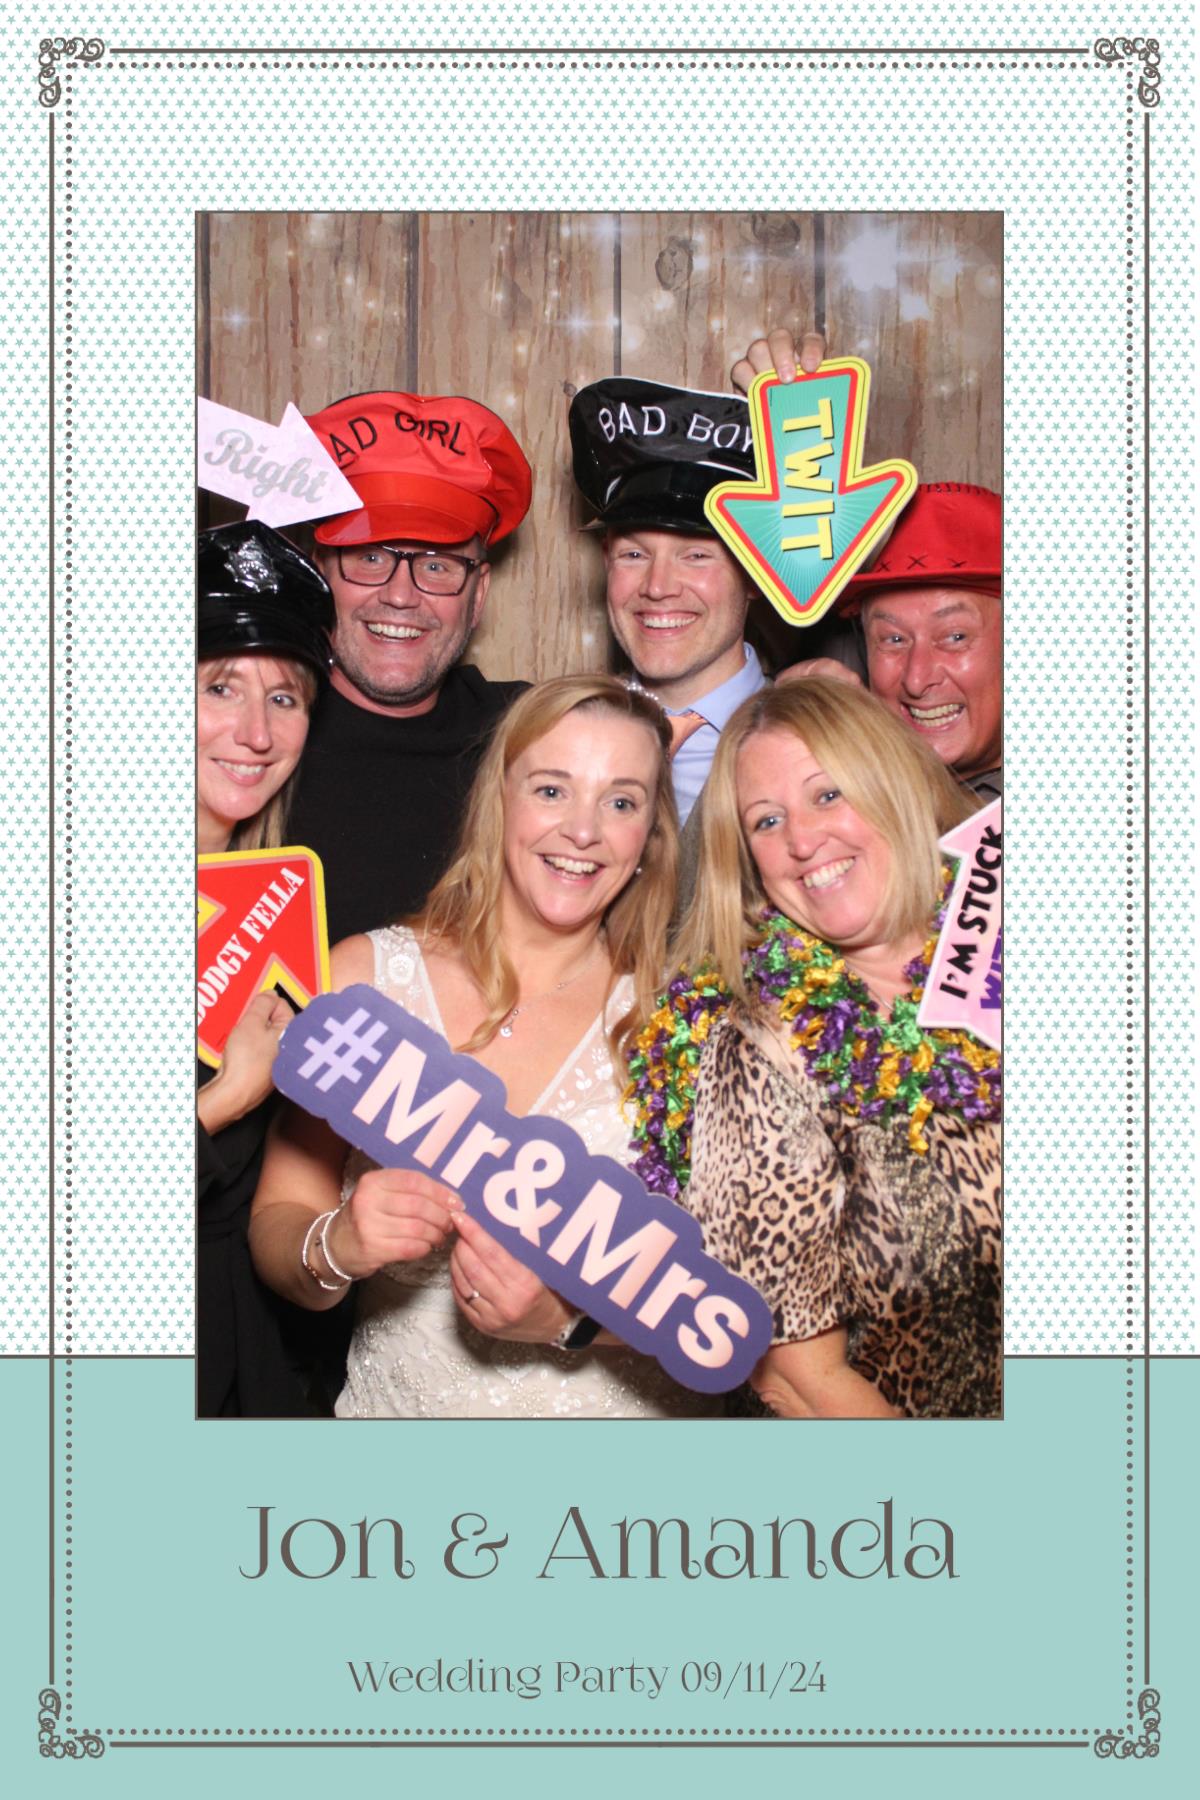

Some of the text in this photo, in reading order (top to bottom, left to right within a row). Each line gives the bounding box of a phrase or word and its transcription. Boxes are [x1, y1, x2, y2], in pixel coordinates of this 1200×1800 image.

[329, 410, 470, 462] AD GIRL
[598, 402, 753, 452] BAD BOY
[204, 428, 331, 504] Right
[781, 397, 834, 560] TWIT
[239, 867, 304, 943] FELLA
[957, 825, 1001, 934] STUCK
[939, 944, 978, 999] I'M
[297, 1007, 750, 1369] #Mr&Mrs
